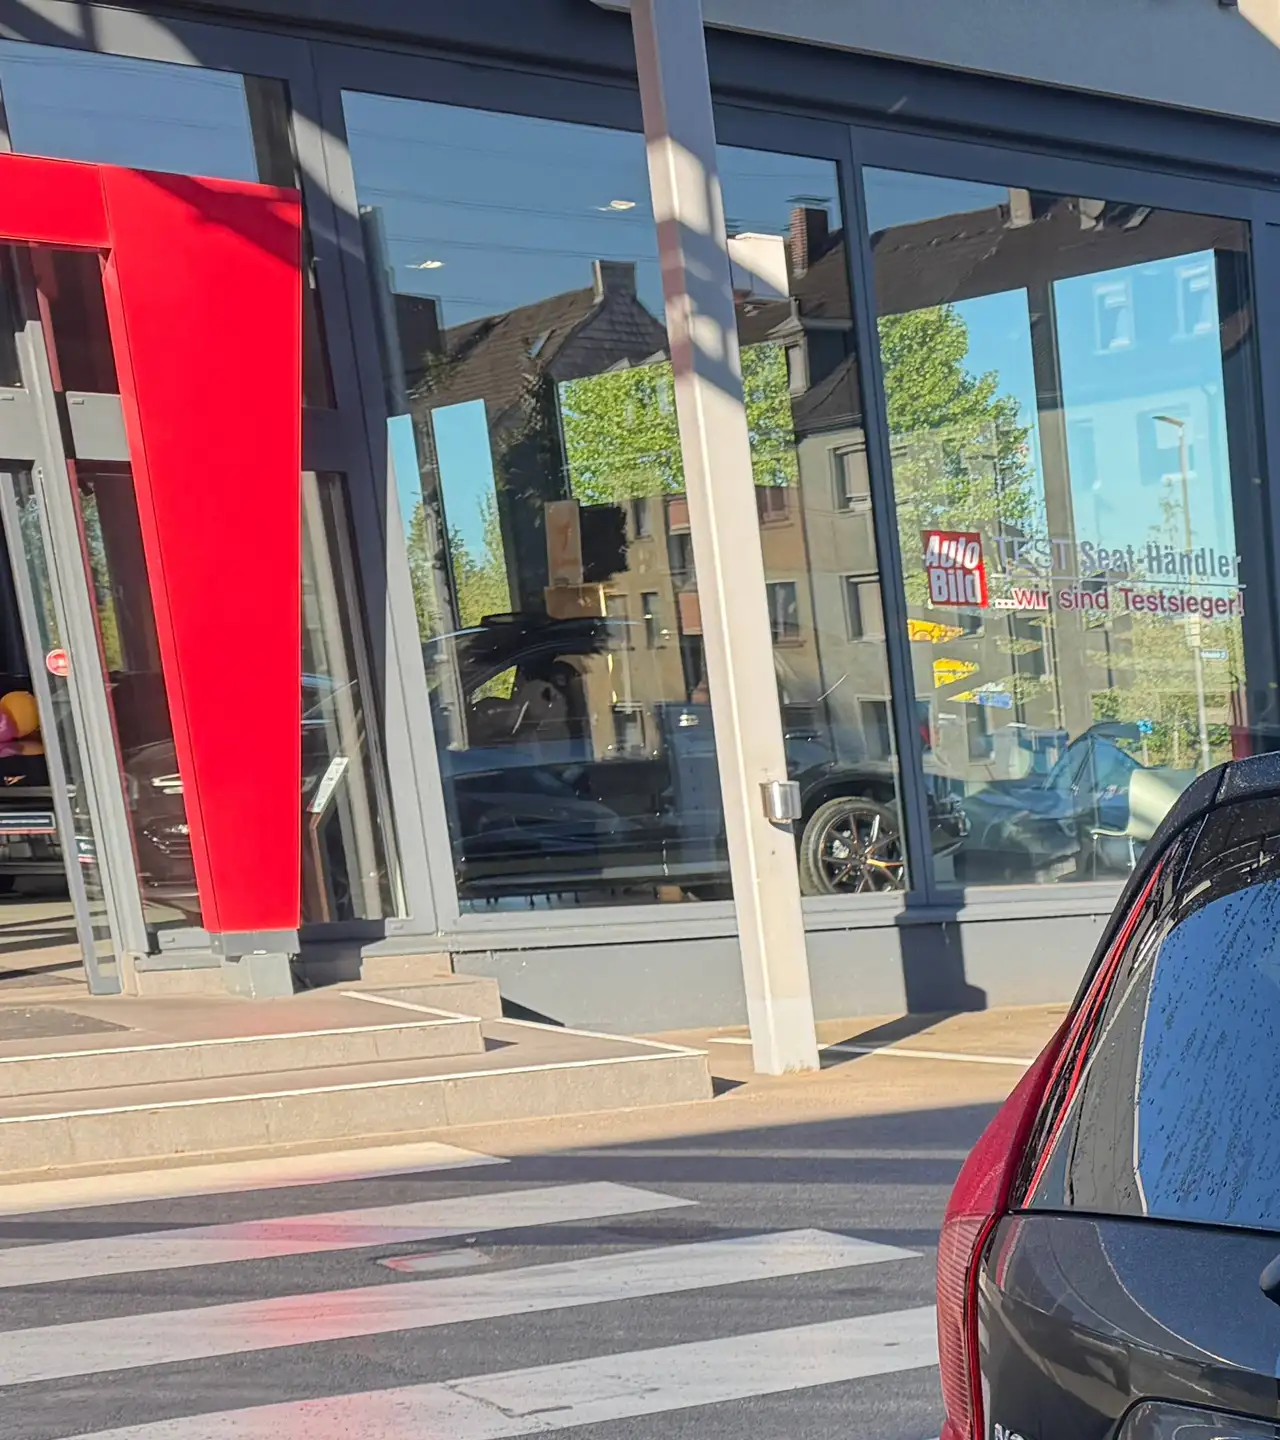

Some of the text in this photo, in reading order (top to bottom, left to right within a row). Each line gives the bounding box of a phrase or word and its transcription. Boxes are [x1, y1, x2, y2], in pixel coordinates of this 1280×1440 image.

[926, 535, 980, 568] Auto
[1081, 540, 1242, 578] Seat-Händler
[930, 568, 981, 603] Bild
[1060, 588, 1109, 610] sind
[1120, 588, 1244, 618] Testsieger!
